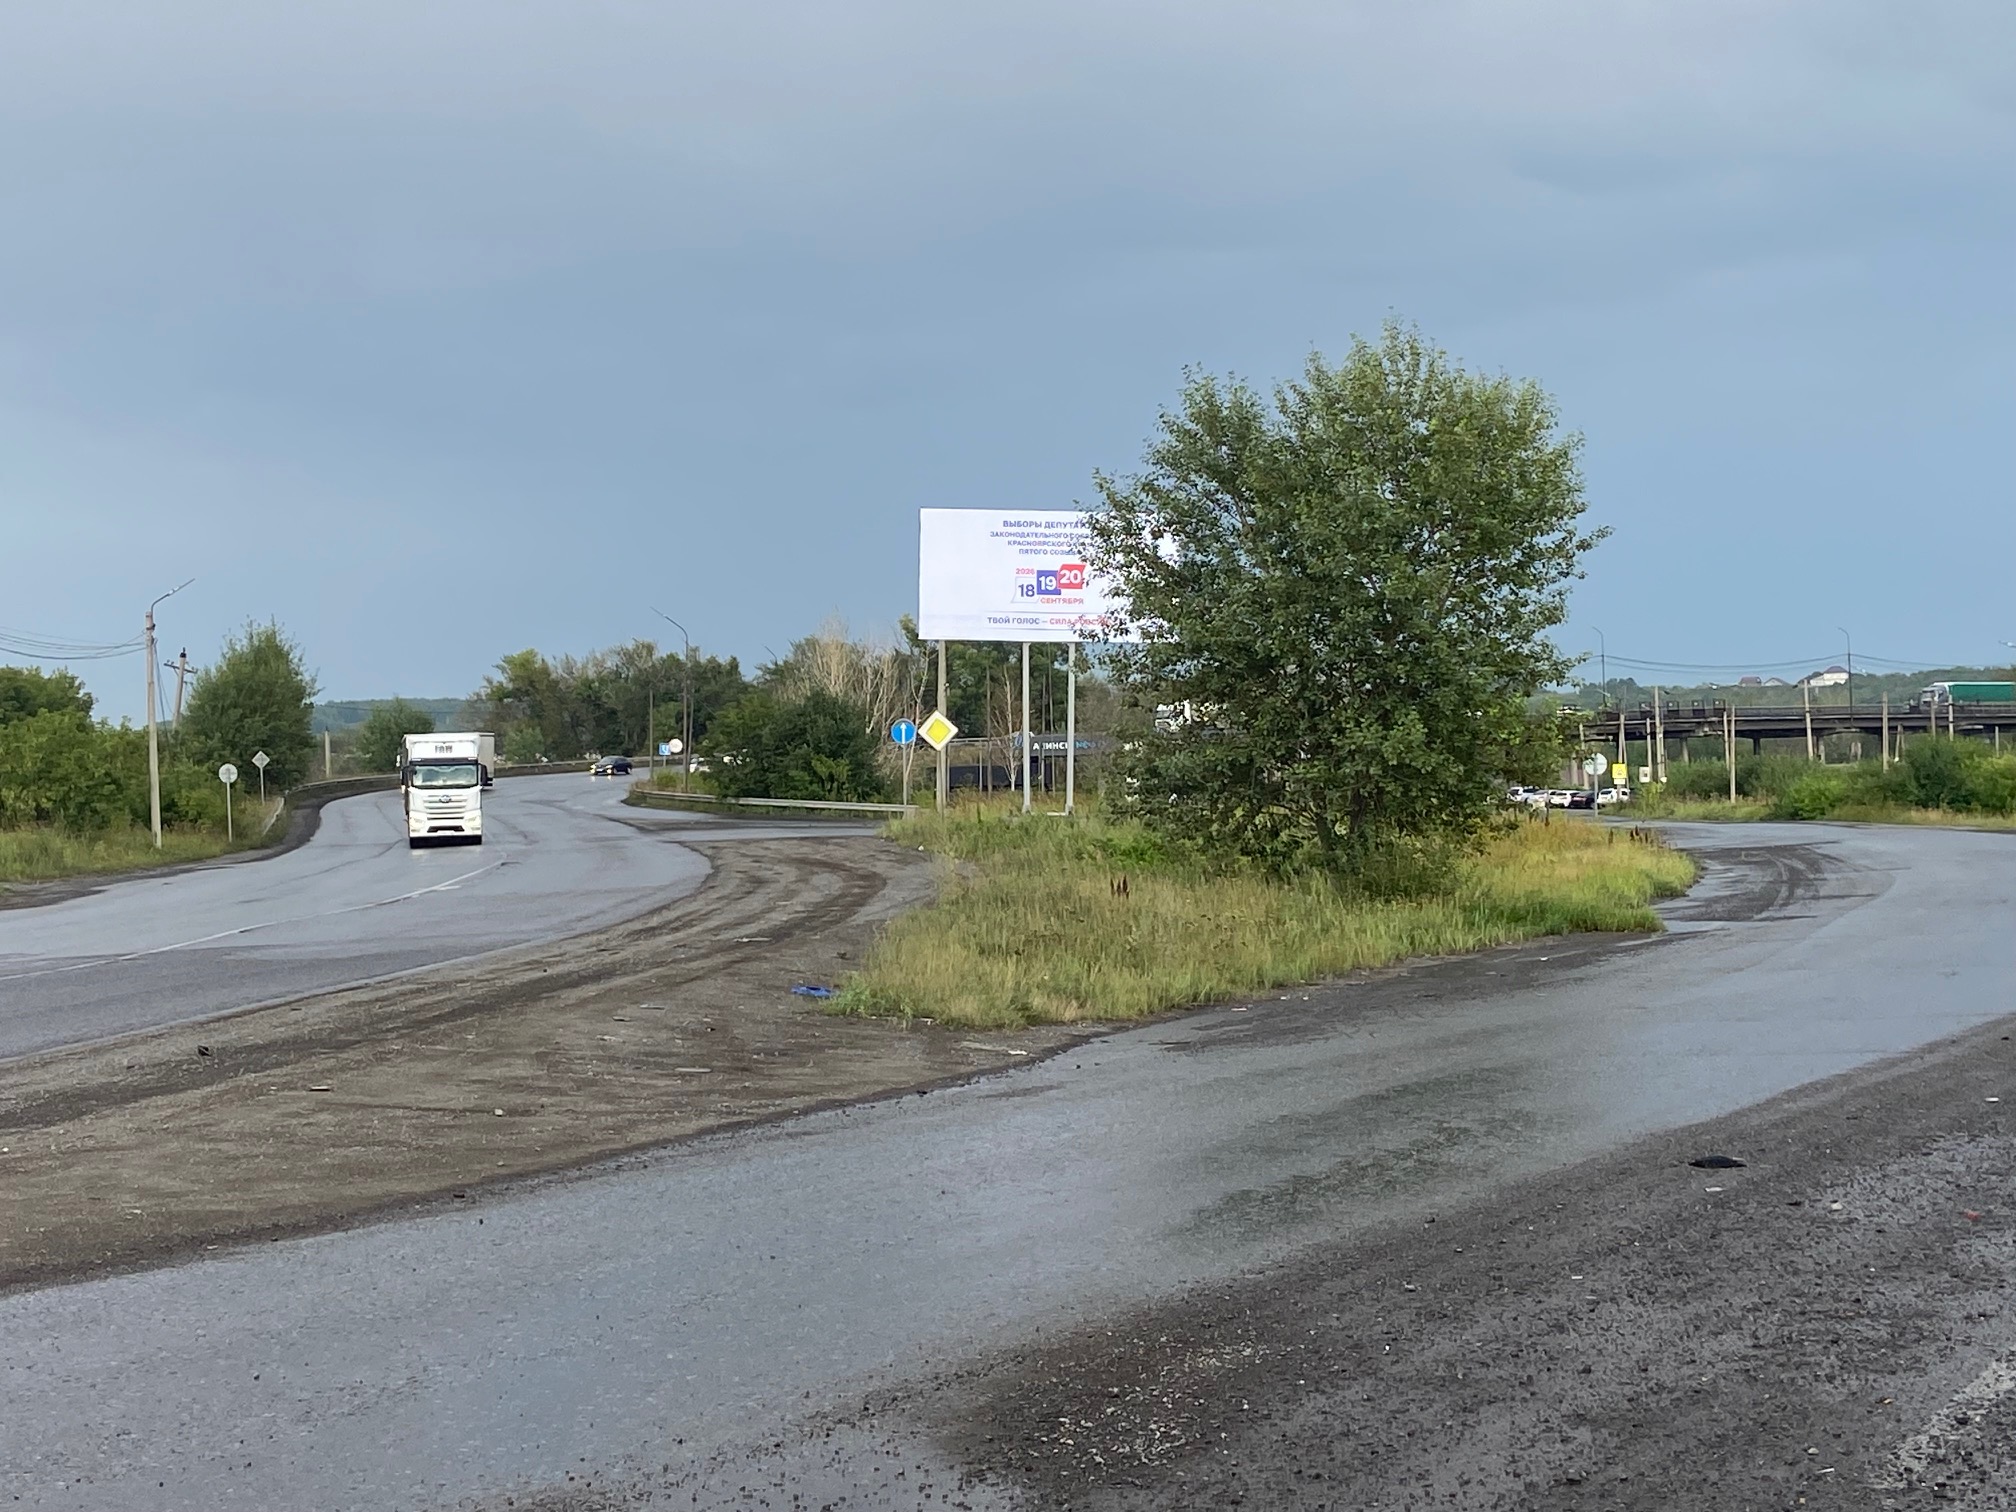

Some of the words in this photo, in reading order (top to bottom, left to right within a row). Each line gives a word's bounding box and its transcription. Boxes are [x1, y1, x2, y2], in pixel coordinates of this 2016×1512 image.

[1003, 520, 1042, 528] ВЫБОРЫ
[990, 531, 1069, 539] ЗАКОНОДАТЕЛЬНОГО
[1007, 540, 1071, 548] КРАСНОЯРСКОГО
[1018, 584, 1035, 597] 18
[1038, 576, 1057, 591] 19
[1059, 569, 1082, 584] 20
[1040, 597, 1084, 605] СЕНТЯБРЯ
[987, 616, 1010, 624] ТВОЙ
[1012, 617, 1040, 625] ГОЛОС
